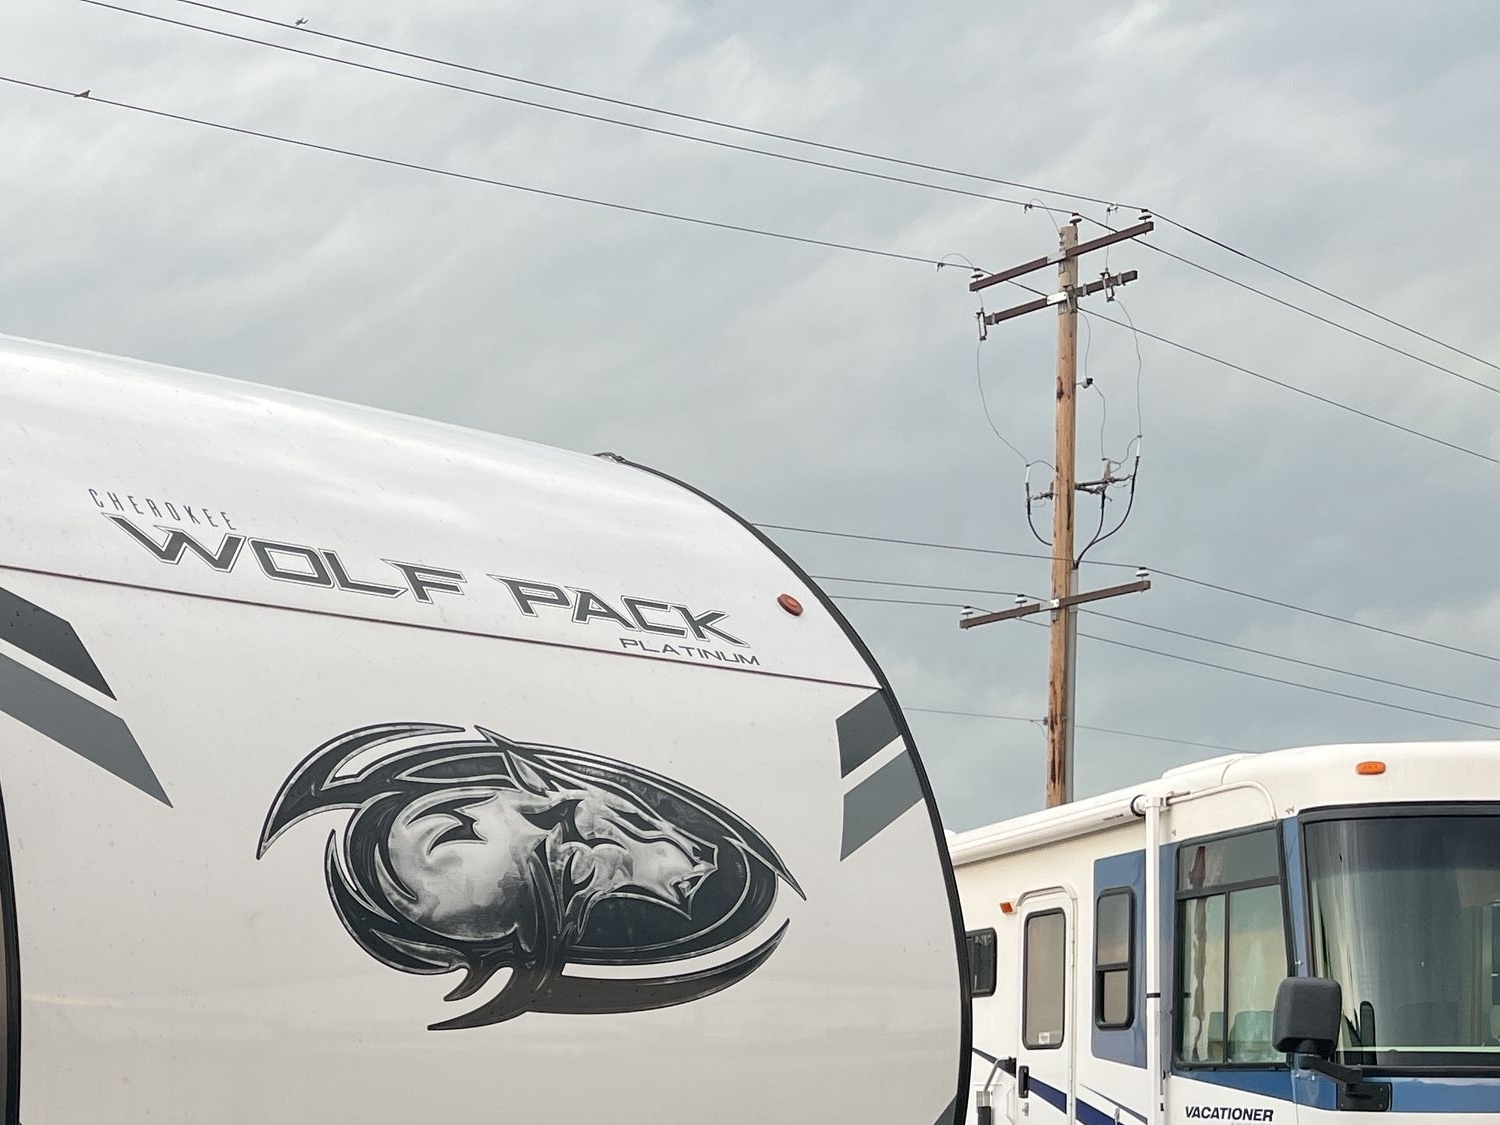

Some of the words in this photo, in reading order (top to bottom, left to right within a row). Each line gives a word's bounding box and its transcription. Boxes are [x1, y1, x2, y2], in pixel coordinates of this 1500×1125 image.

[88, 488, 237, 531] CHEROKEE
[101, 512, 467, 605] WOLF
[485, 573, 751, 649] PACK
[619, 637, 760, 666] PLATINUM
[1185, 1106, 1274, 1122] VACATIONER
